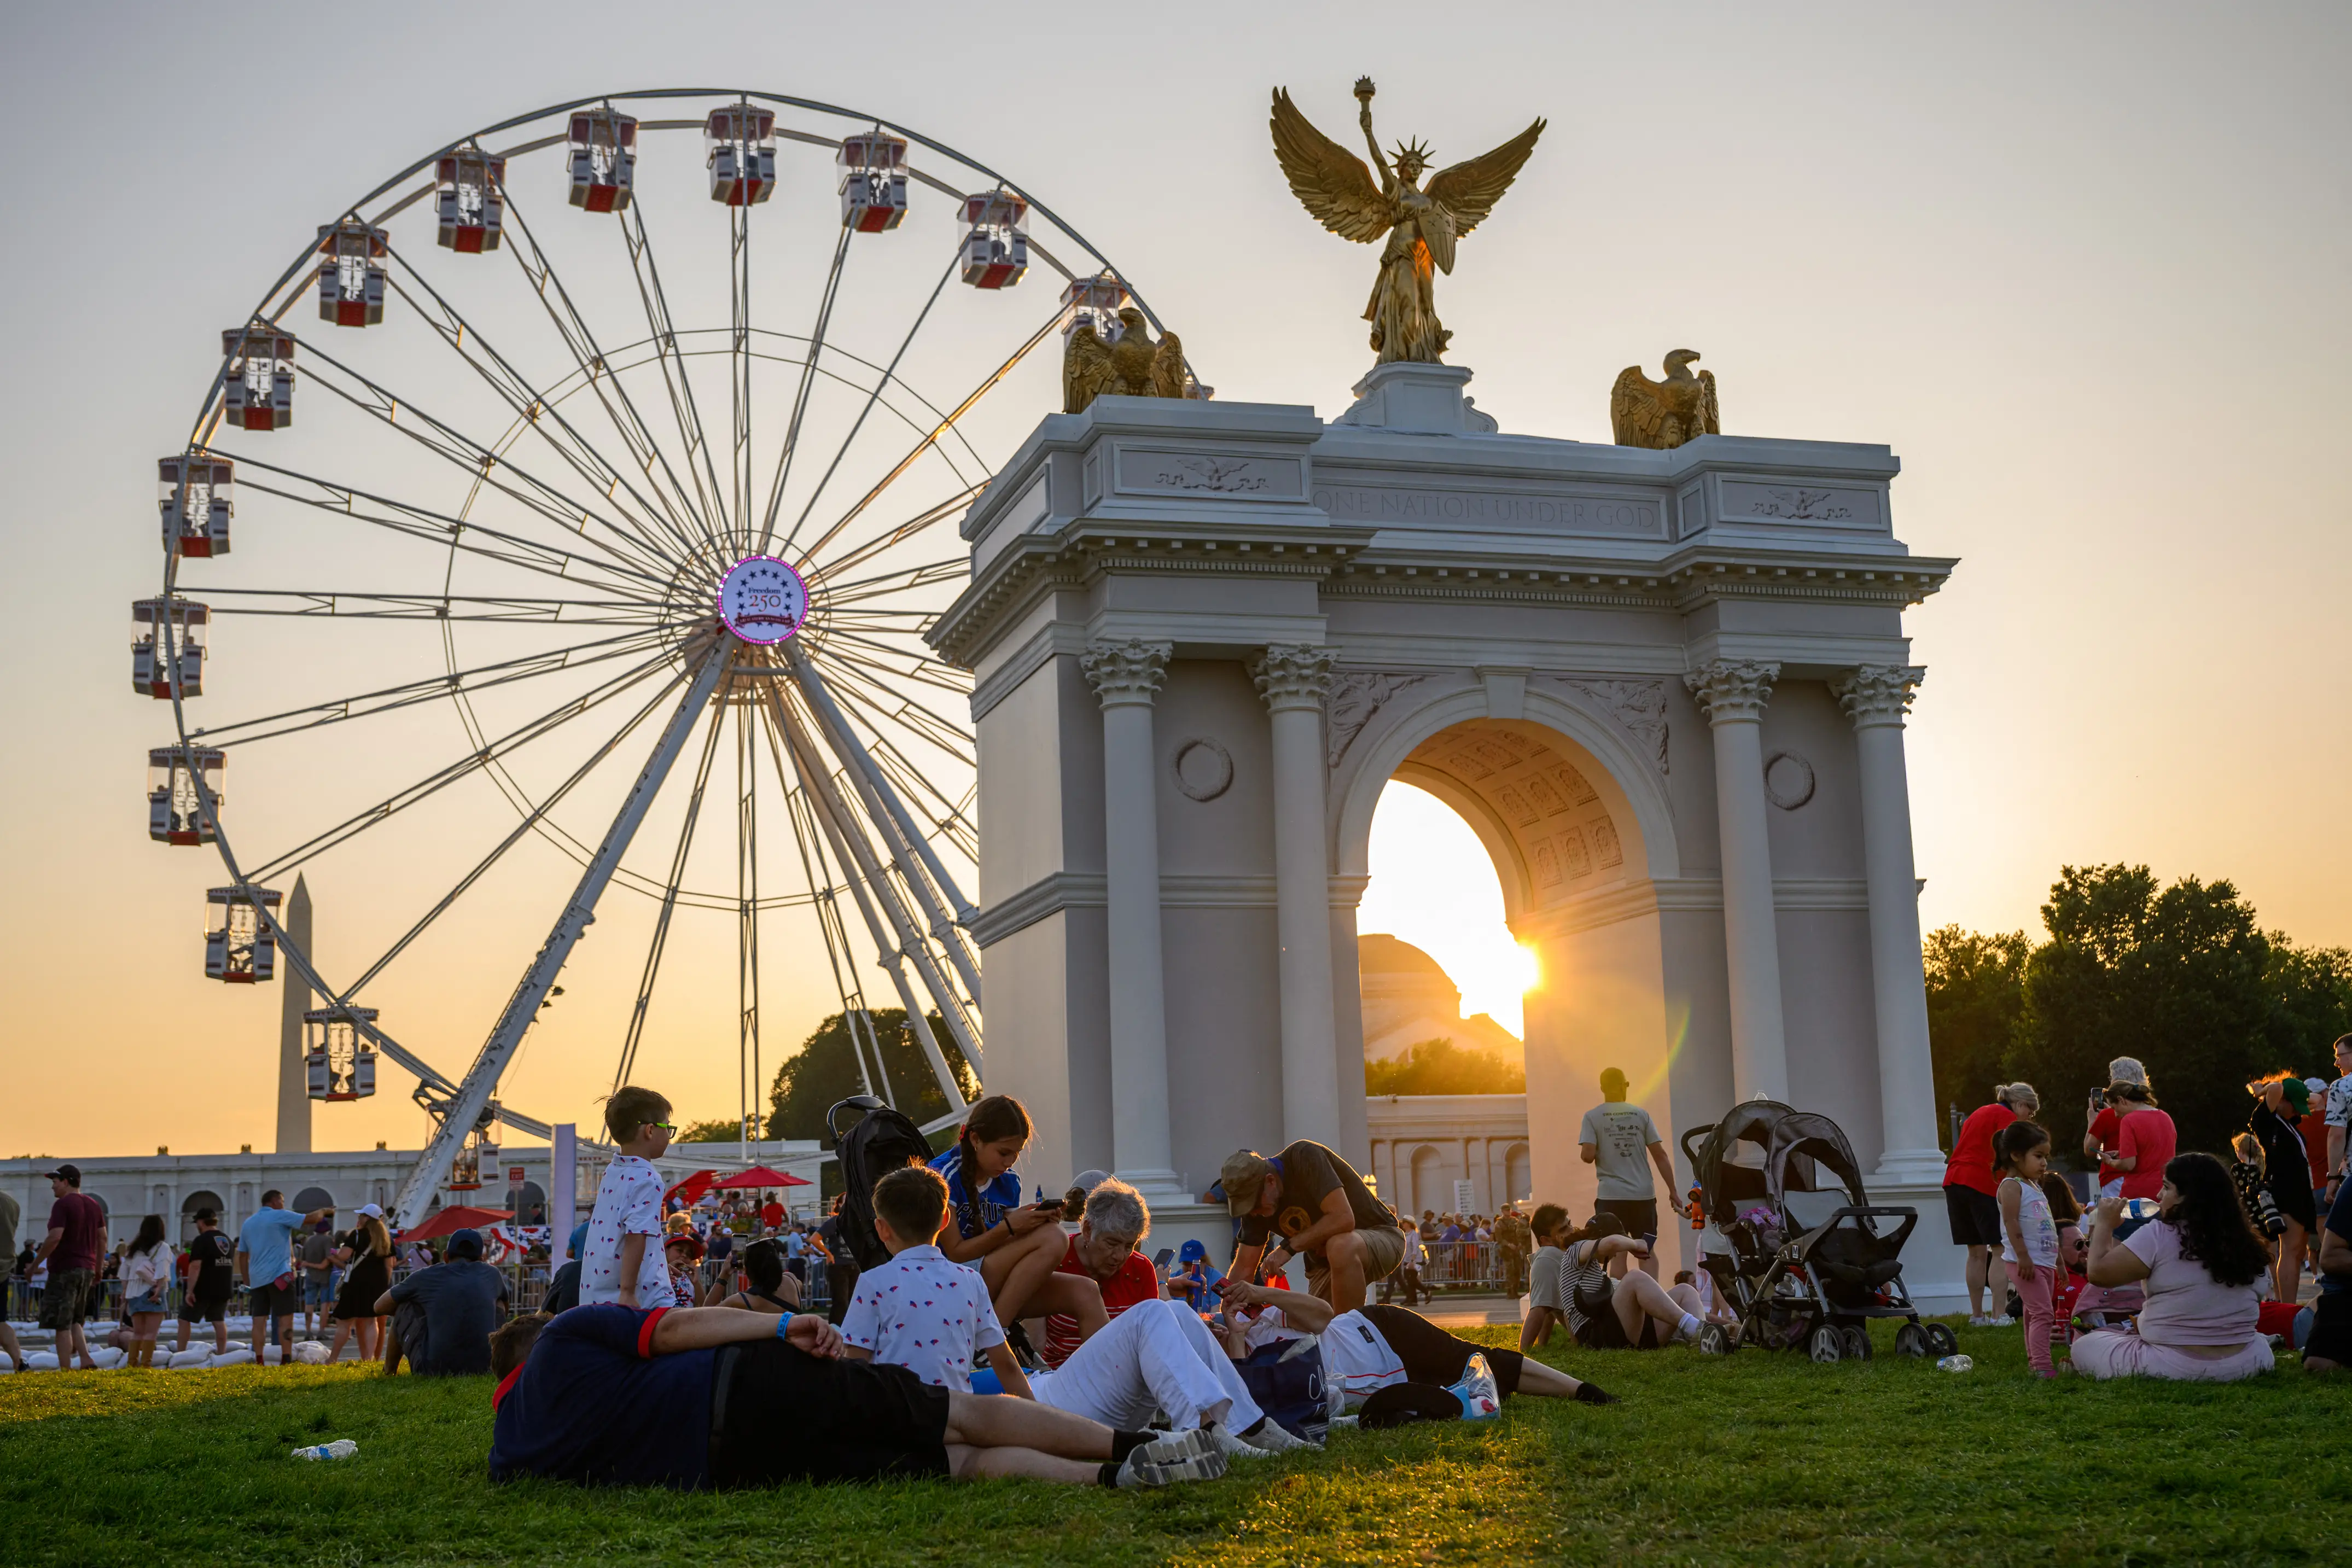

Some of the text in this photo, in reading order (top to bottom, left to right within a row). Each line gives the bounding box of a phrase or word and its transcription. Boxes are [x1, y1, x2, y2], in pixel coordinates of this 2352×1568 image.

[1313, 491, 1654, 527] ONE NATION UNDER GOD
[749, 594, 781, 611] 250
